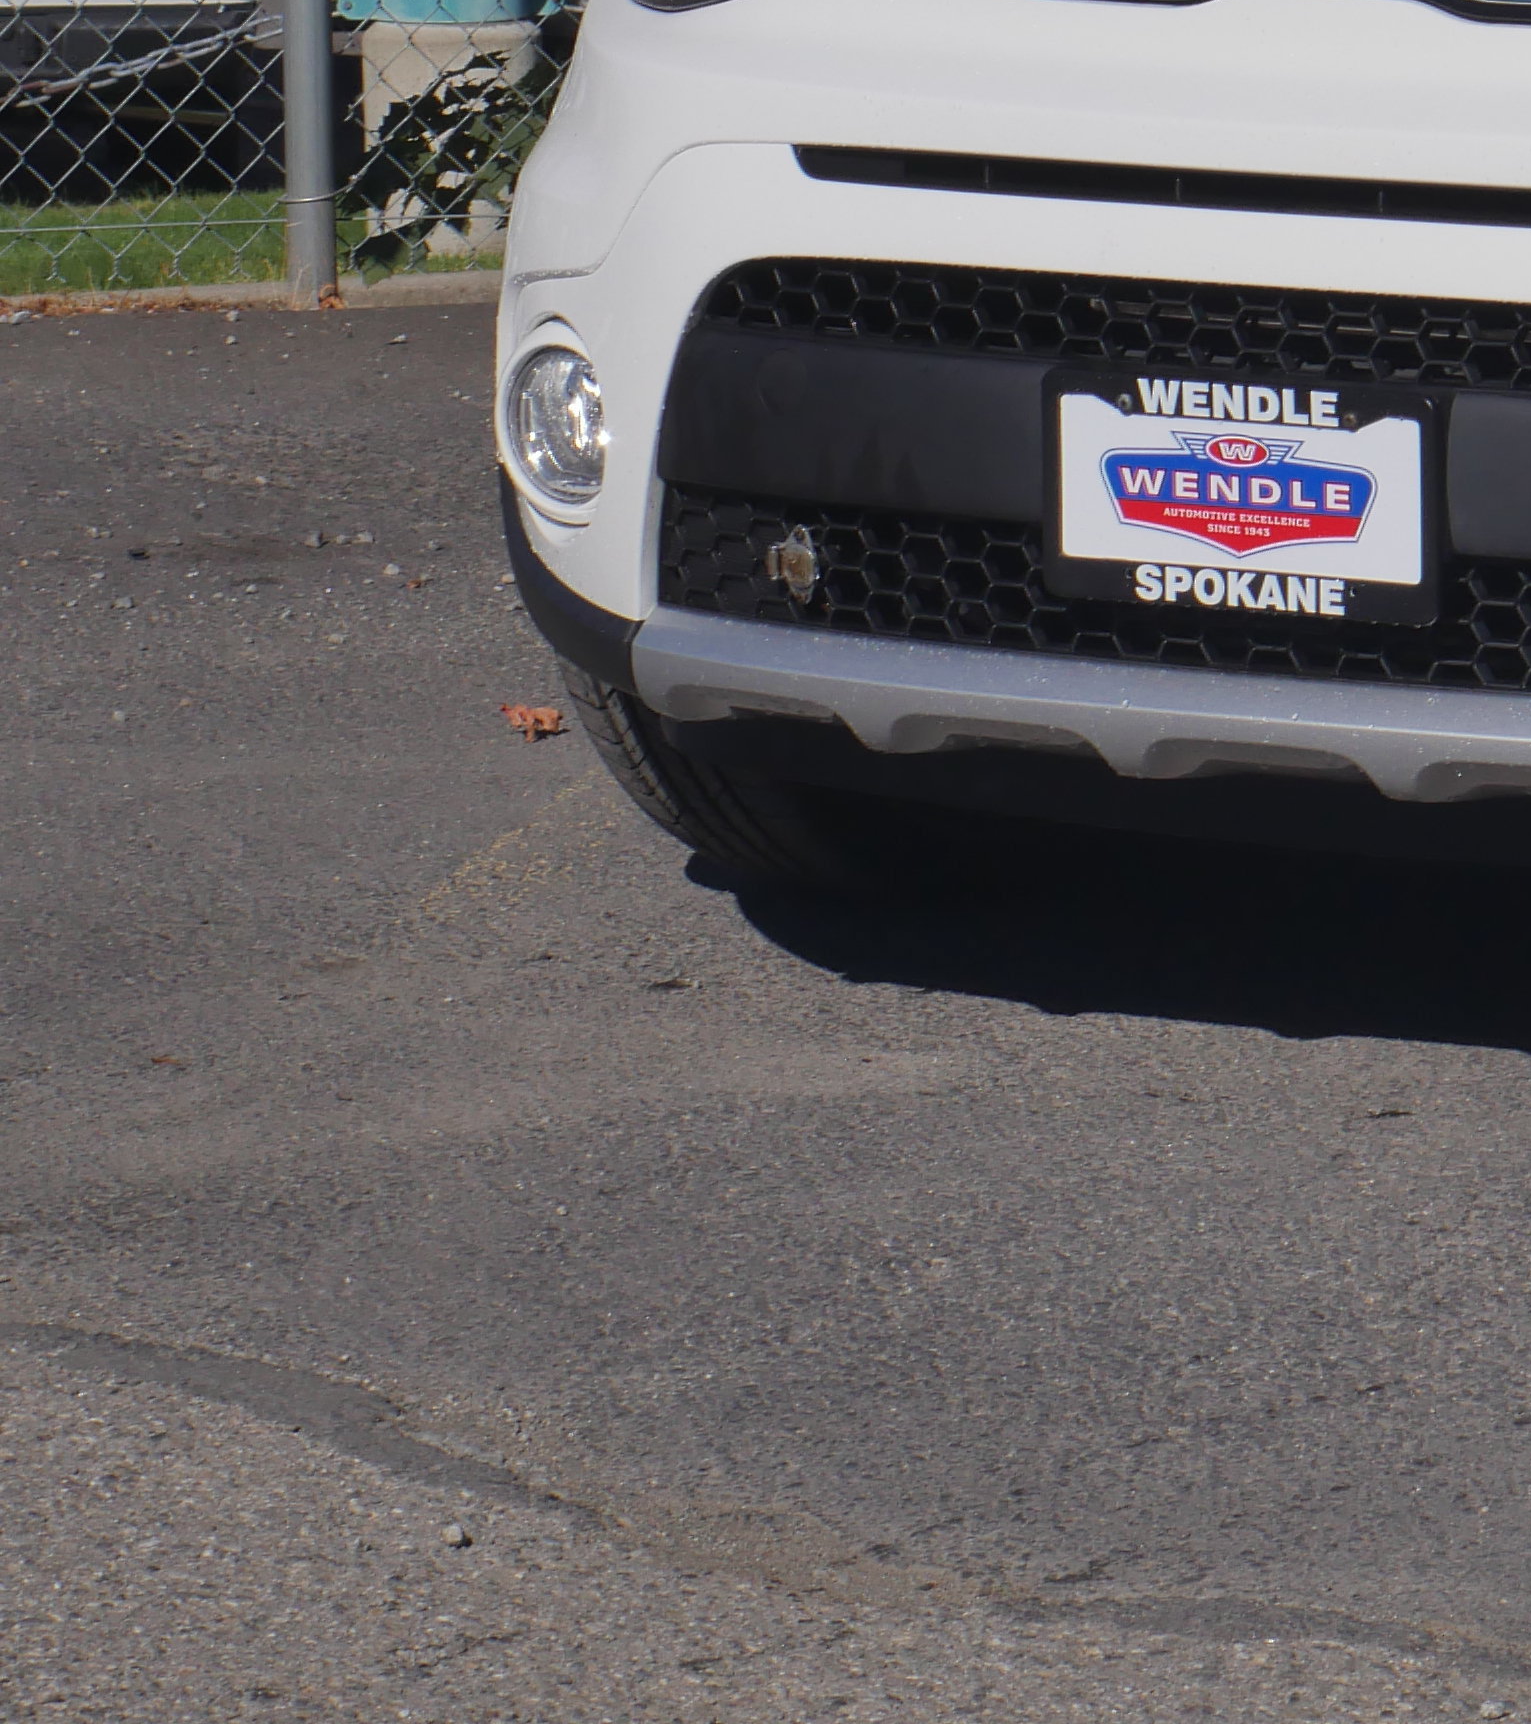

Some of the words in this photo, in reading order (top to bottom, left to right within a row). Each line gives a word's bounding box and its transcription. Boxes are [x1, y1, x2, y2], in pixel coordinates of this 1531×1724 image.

[1137, 378, 1339, 427] WENDLE
[1119, 466, 1352, 511] WENDLE
[1163, 507, 1236, 522] AUTOMOTIVE
[1239, 513, 1311, 528] EXCELLENCE
[1207, 523, 1241, 535] SINCE
[1244, 526, 1271, 537] 1943
[1135, 564, 1346, 616] SPOKANE
